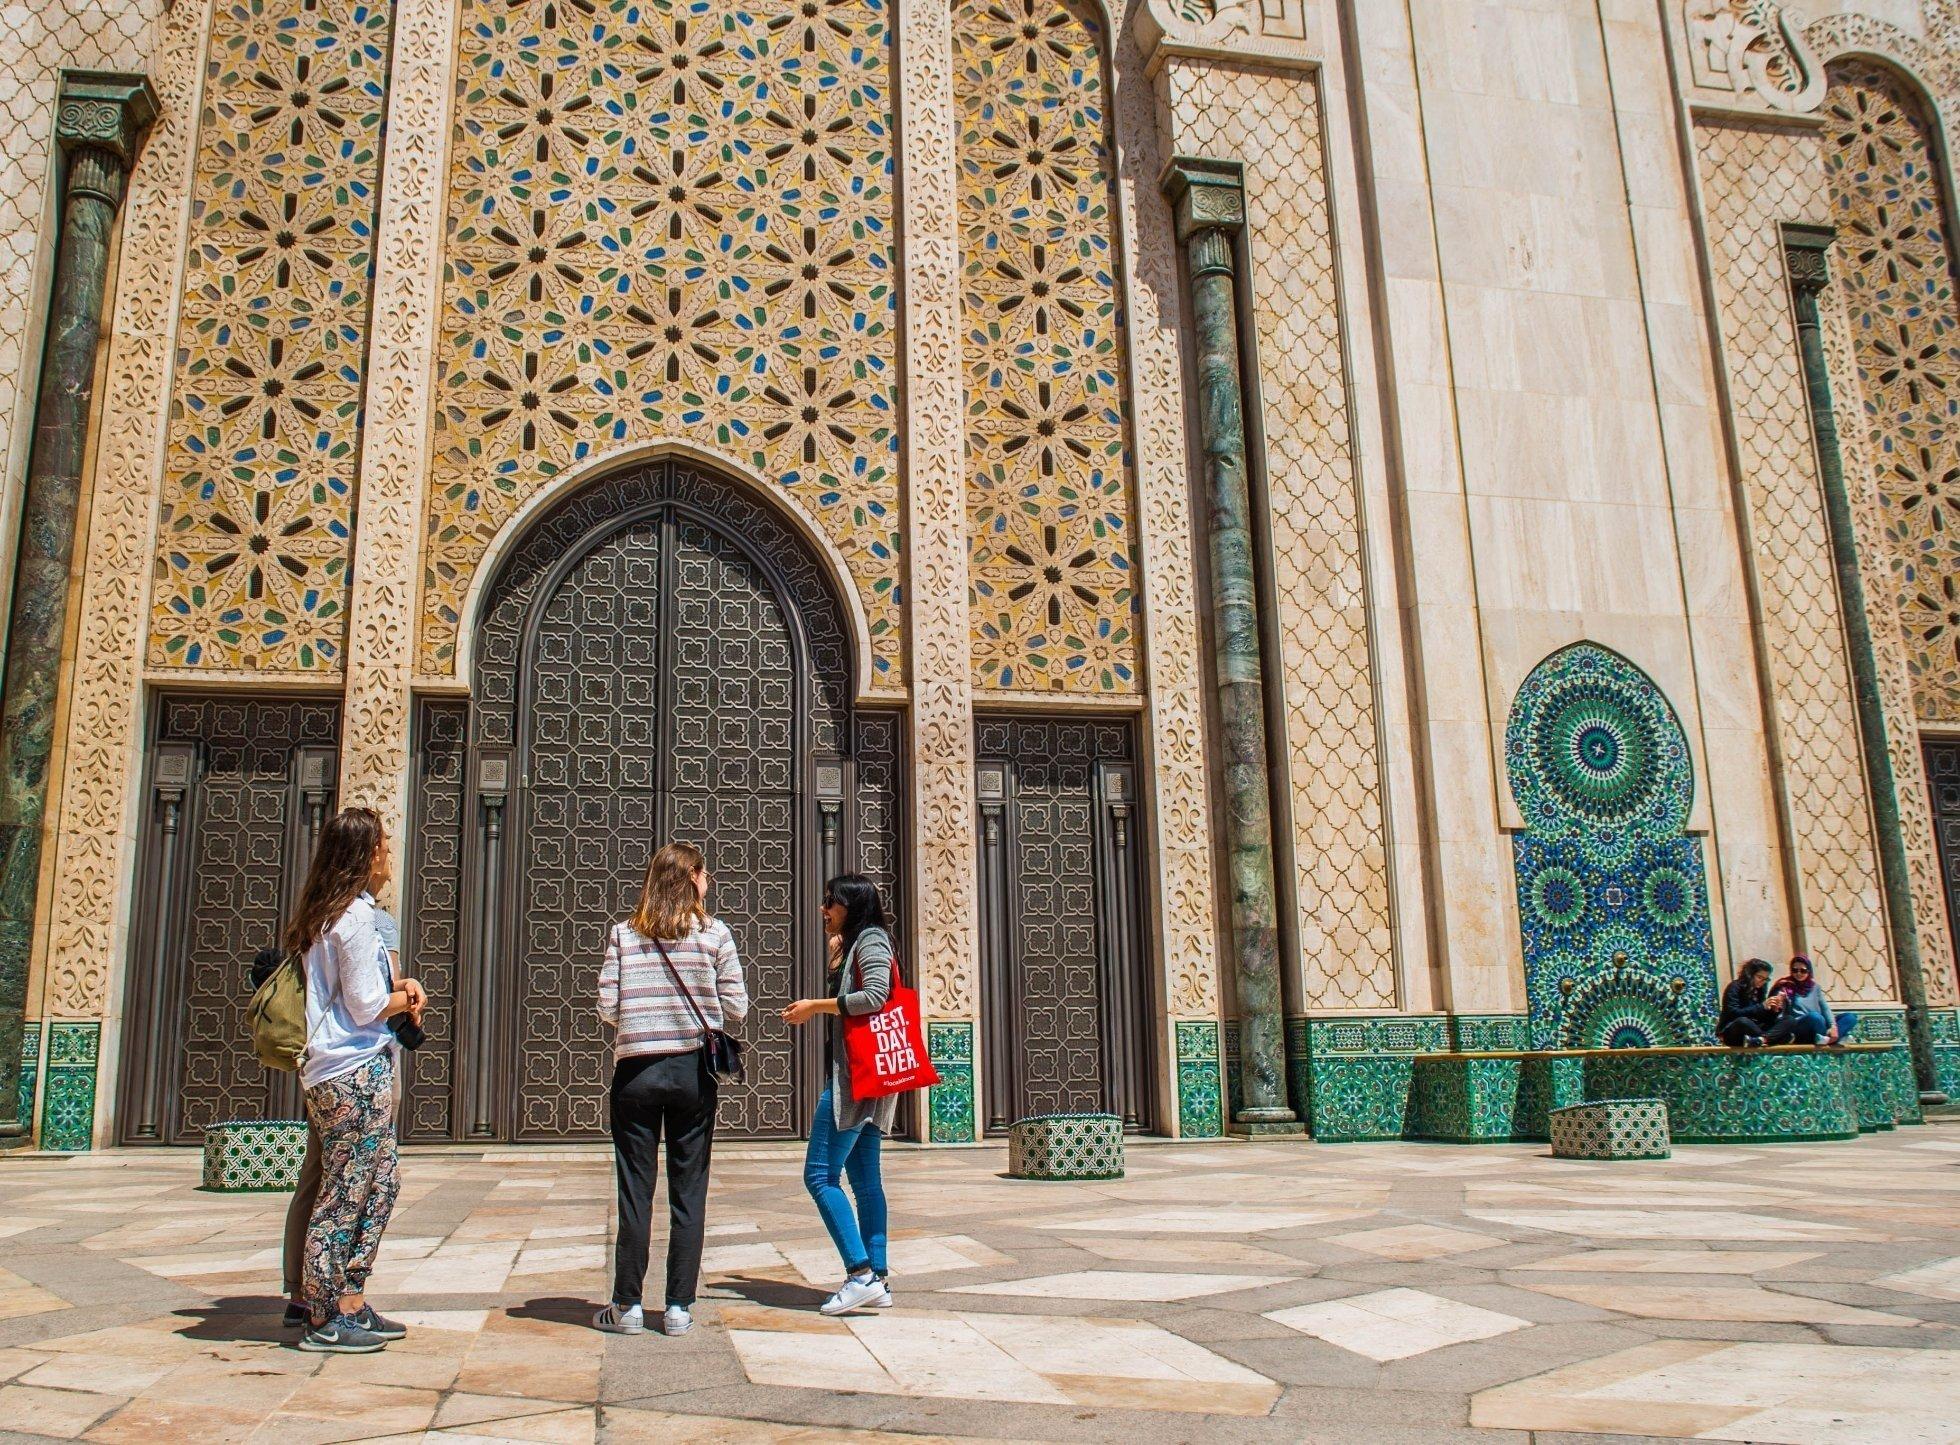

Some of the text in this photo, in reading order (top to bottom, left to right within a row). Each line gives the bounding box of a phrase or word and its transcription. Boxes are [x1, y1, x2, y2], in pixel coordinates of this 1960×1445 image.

[869, 1006, 909, 1033] BEST.
[876, 1027, 911, 1053] DAY.
[875, 1048, 920, 1076] EVER.
